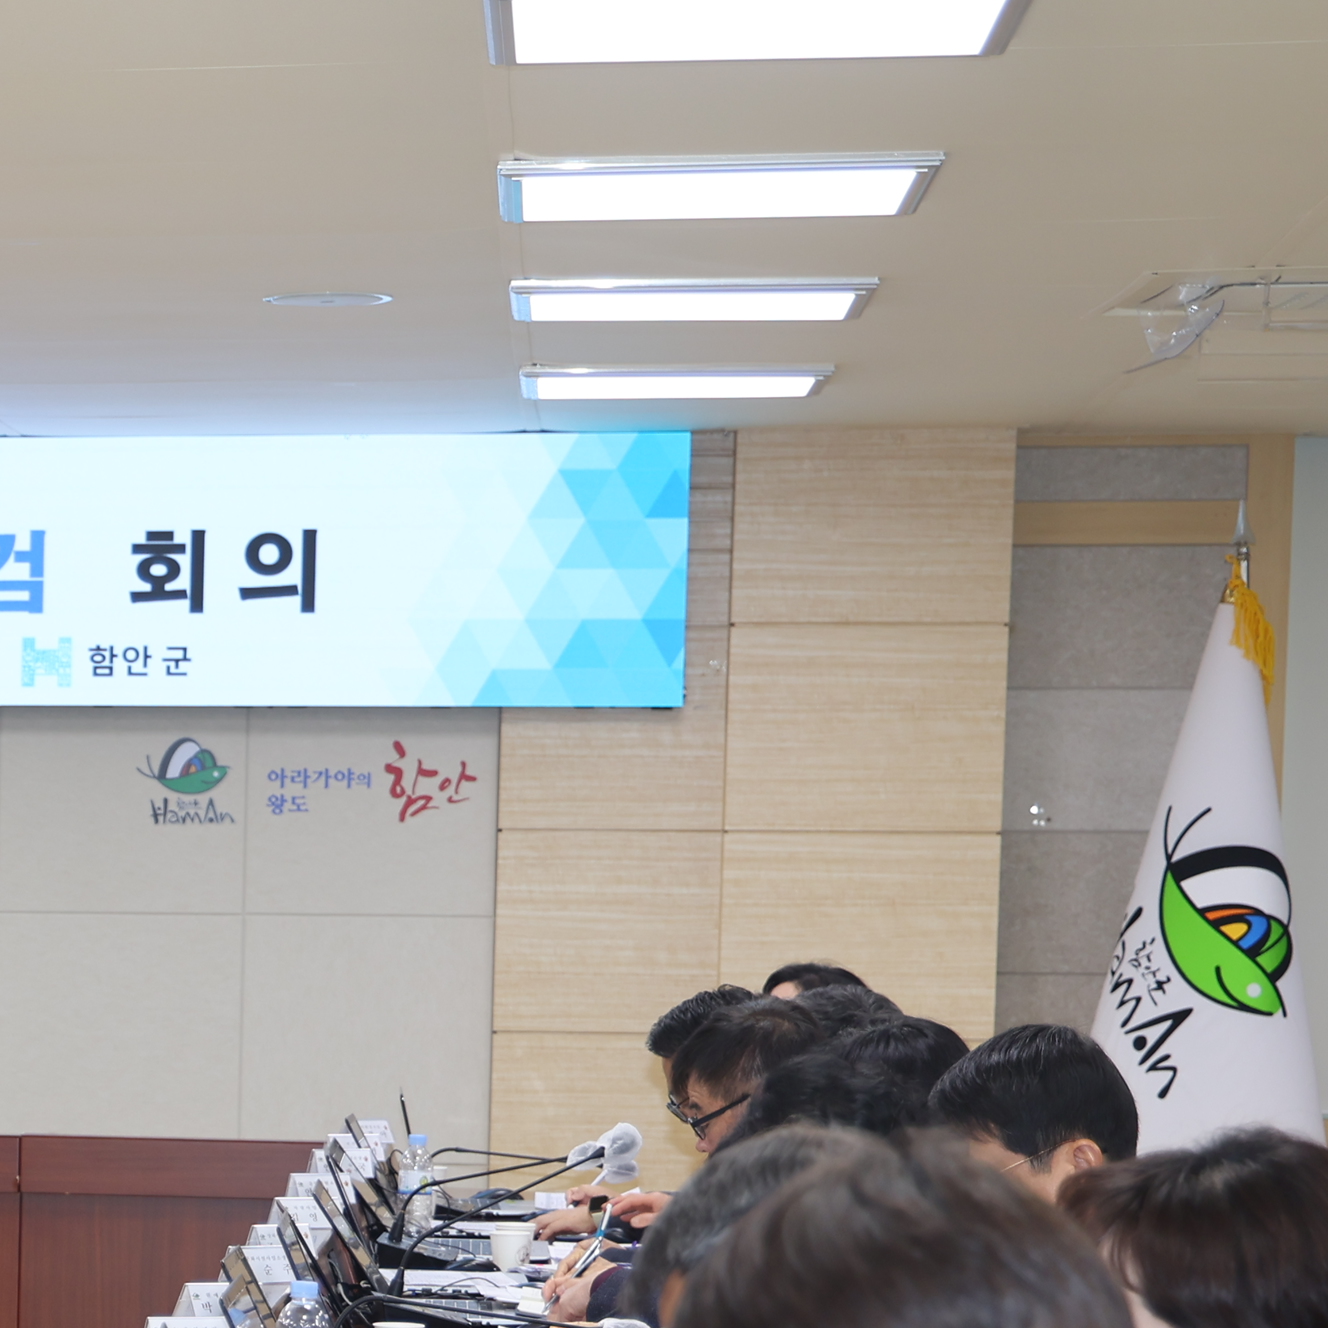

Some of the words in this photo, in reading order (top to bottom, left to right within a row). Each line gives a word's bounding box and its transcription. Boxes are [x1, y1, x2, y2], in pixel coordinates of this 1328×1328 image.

[129, 529, 318, 614] 회의
[267, 767, 372, 789] 아라가야의
[384, 739, 478, 823] 함안
[266, 794, 310, 816] 왕도
